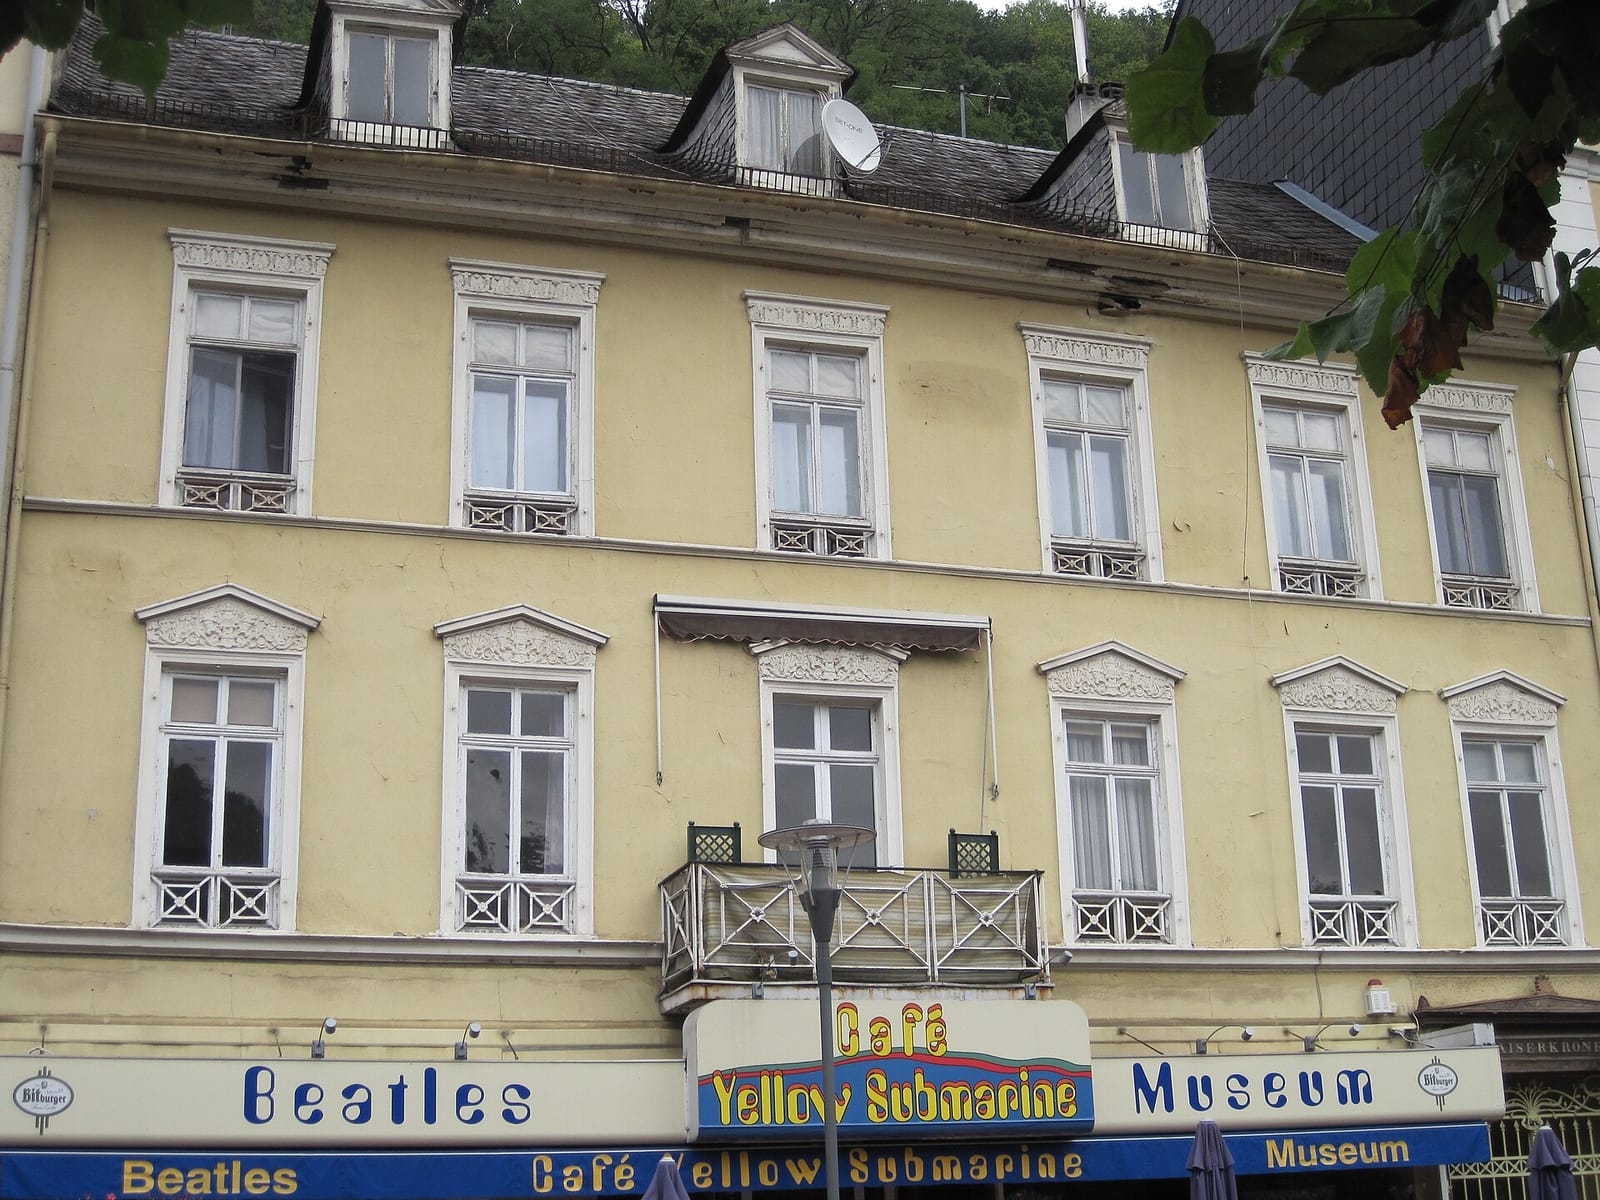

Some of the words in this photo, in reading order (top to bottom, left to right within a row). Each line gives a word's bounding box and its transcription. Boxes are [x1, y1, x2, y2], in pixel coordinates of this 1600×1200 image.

[837, 1002, 947, 1057] Café
[22, 1088, 66, 1105] Bitburger
[243, 1065, 531, 1125] Beatles
[712, 1069, 852, 1126] Yellow
[866, 1066, 1078, 1123] Submarine
[1133, 1061, 1373, 1114] Museum
[1423, 1073, 1454, 1086] Bitburger
[122, 1160, 298, 1194] Beatles
[532, 1153, 635, 1193] Café
[850, 1144, 1082, 1184] Submarine
[1266, 1139, 1410, 1169] Museum
